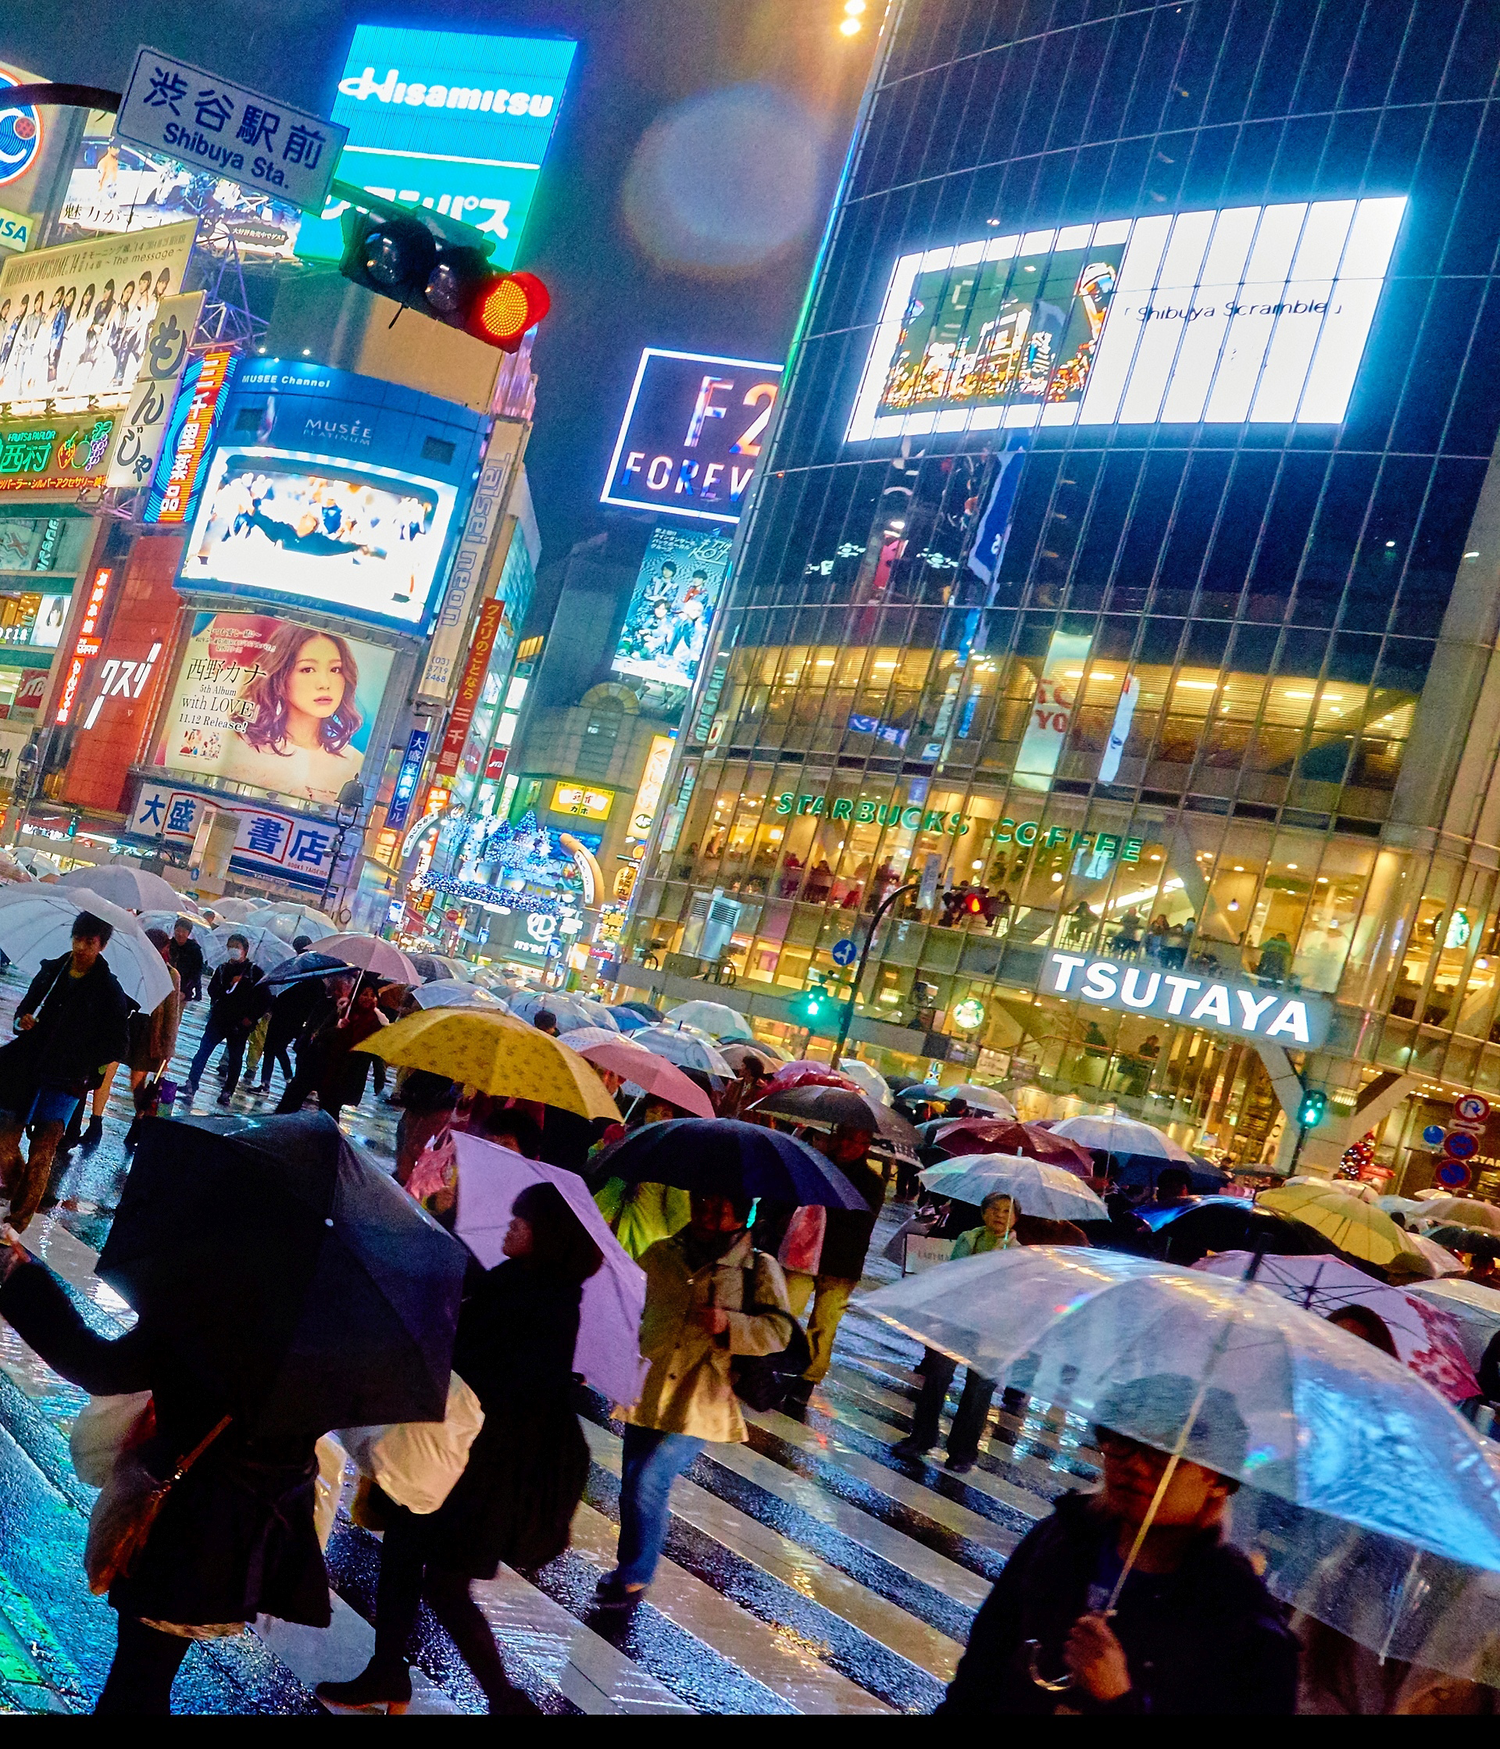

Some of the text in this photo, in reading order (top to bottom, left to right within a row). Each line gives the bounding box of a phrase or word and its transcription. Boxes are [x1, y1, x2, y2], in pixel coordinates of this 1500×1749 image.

[338, 67, 555, 118] Hisamitsu
[142, 66, 327, 170] 渋谷駅前
[162, 121, 290, 190] Shibuya Sta.
[1135, 299, 1328, 322] Shibuya Scramble
[116, 314, 188, 482] もんじゃ
[241, 374, 331, 388] MUSEE Channel
[160, 359, 220, 512] 三千里薬品
[683, 375, 780, 457] F2
[0, 442, 53, 473] 西村
[302, 428, 371, 446] PLATINUM
[621, 451, 755, 502] FOREV
[441, 550, 478, 627] neon
[186, 657, 268, 687] 西野カナ
[425, 673, 447, 684] 2468
[431, 656, 450, 667] (03)
[199, 684, 237, 697] 5th Album
[210, 695, 256, 718] LOVE
[439, 604, 501, 769] クスリのことなら 三千里
[178, 713, 249, 733] 11.12 Release!
[776, 791, 1145, 864] STARBUCKS COFFEE
[287, 861, 304, 872] BOOKS
[1051, 952, 1311, 1044] TSUTAYA
